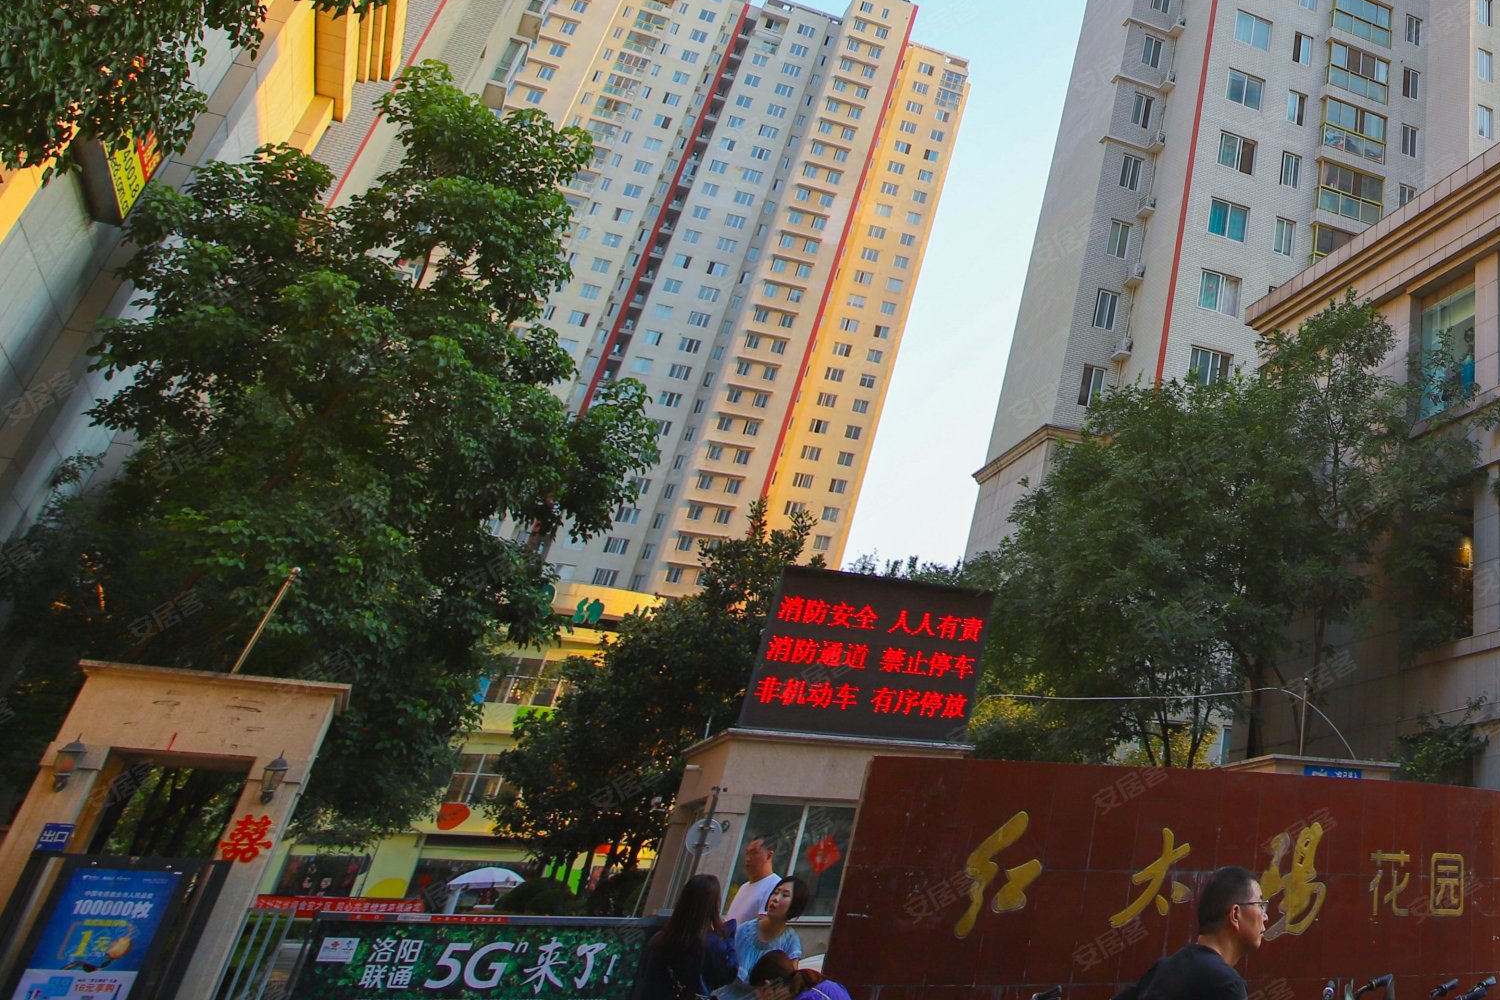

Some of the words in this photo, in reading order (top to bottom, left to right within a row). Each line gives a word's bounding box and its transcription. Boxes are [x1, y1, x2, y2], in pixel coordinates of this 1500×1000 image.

[778, 594, 879, 632] 消防安全
[887, 608, 985, 645] 人人有责
[765, 634, 870, 671] 消防通道
[879, 647, 976, 681] 禁止停车
[754, 676, 860, 711] 非机动车
[870, 686, 969, 720] 有序停放
[40, 829, 70, 844] 出口
[1369, 849, 1466, 919] 花园
[366, 937, 425, 964] 洛阳
[357, 964, 416, 991] 联通
